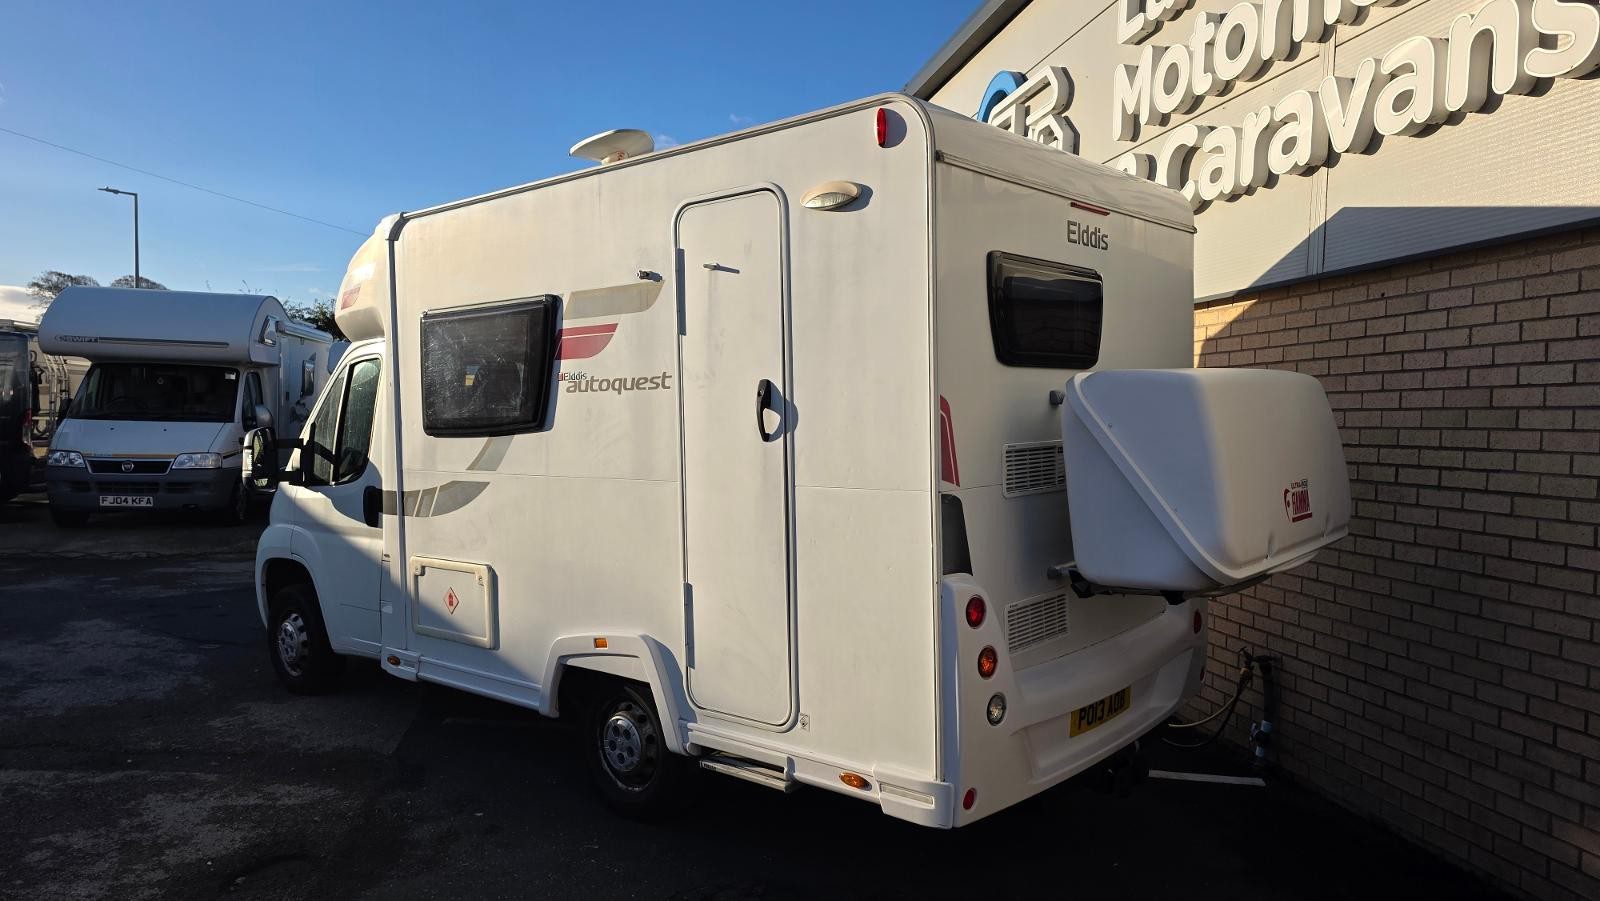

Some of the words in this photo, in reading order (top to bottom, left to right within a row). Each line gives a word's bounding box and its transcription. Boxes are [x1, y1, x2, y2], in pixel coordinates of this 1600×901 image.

[1157, 0, 1600, 202] Caravans
[1066, 220, 1109, 251] Elddis
[563, 371, 588, 381] Elddis
[565, 371, 672, 395] autoquest
[101, 496, 128, 505] FJ04
[131, 496, 152, 505] KFA
